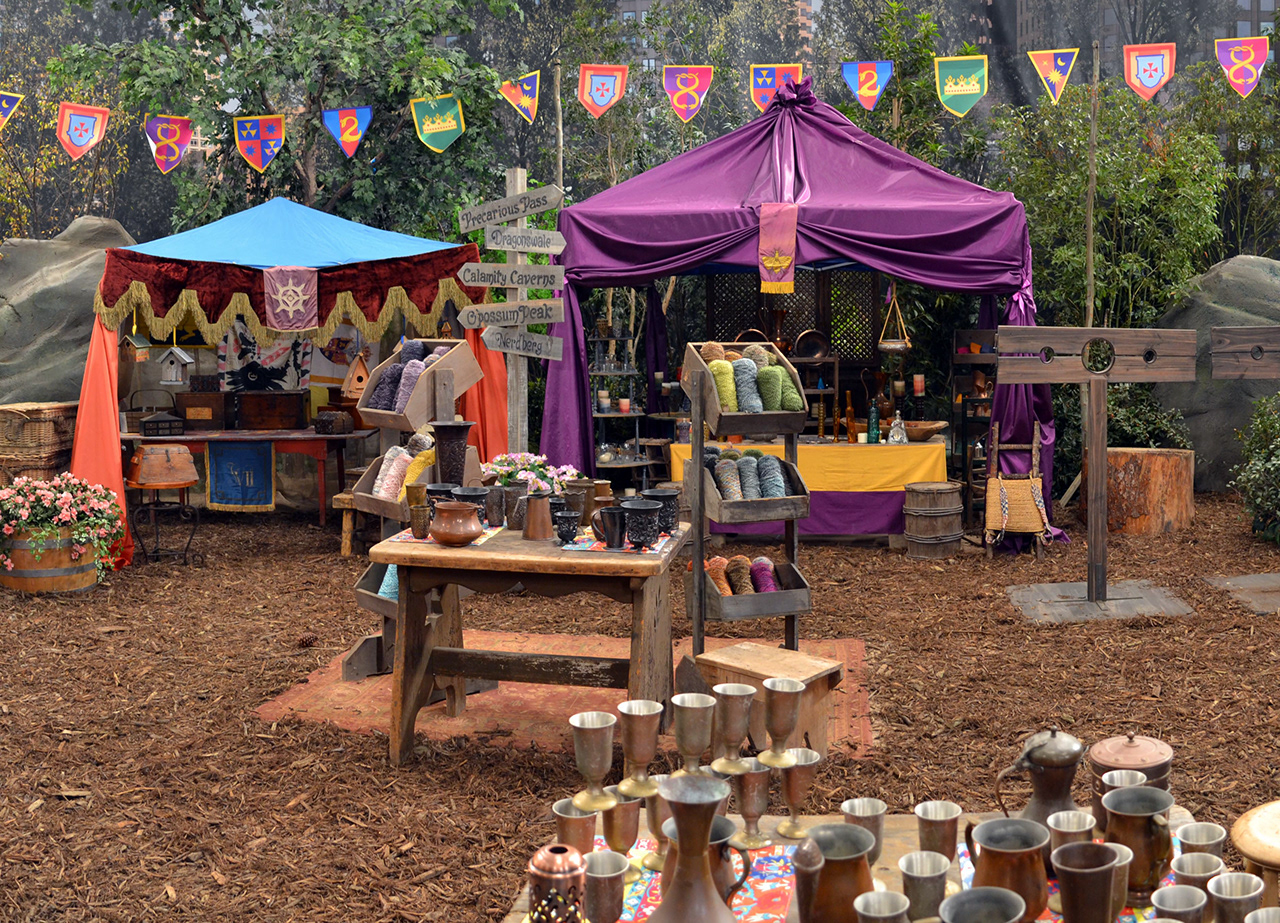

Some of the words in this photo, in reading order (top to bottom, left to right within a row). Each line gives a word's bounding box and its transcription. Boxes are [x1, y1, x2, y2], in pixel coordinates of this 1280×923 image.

[462, 204, 519, 229] Precarious
[520, 195, 548, 213] Pass
[491, 230, 551, 249] Dragonswale
[463, 268, 507, 286] Calamity
[510, 270, 556, 287] Caverns
[518, 305, 553, 324] Peak
[495, 332, 542, 355] Nerdberg
